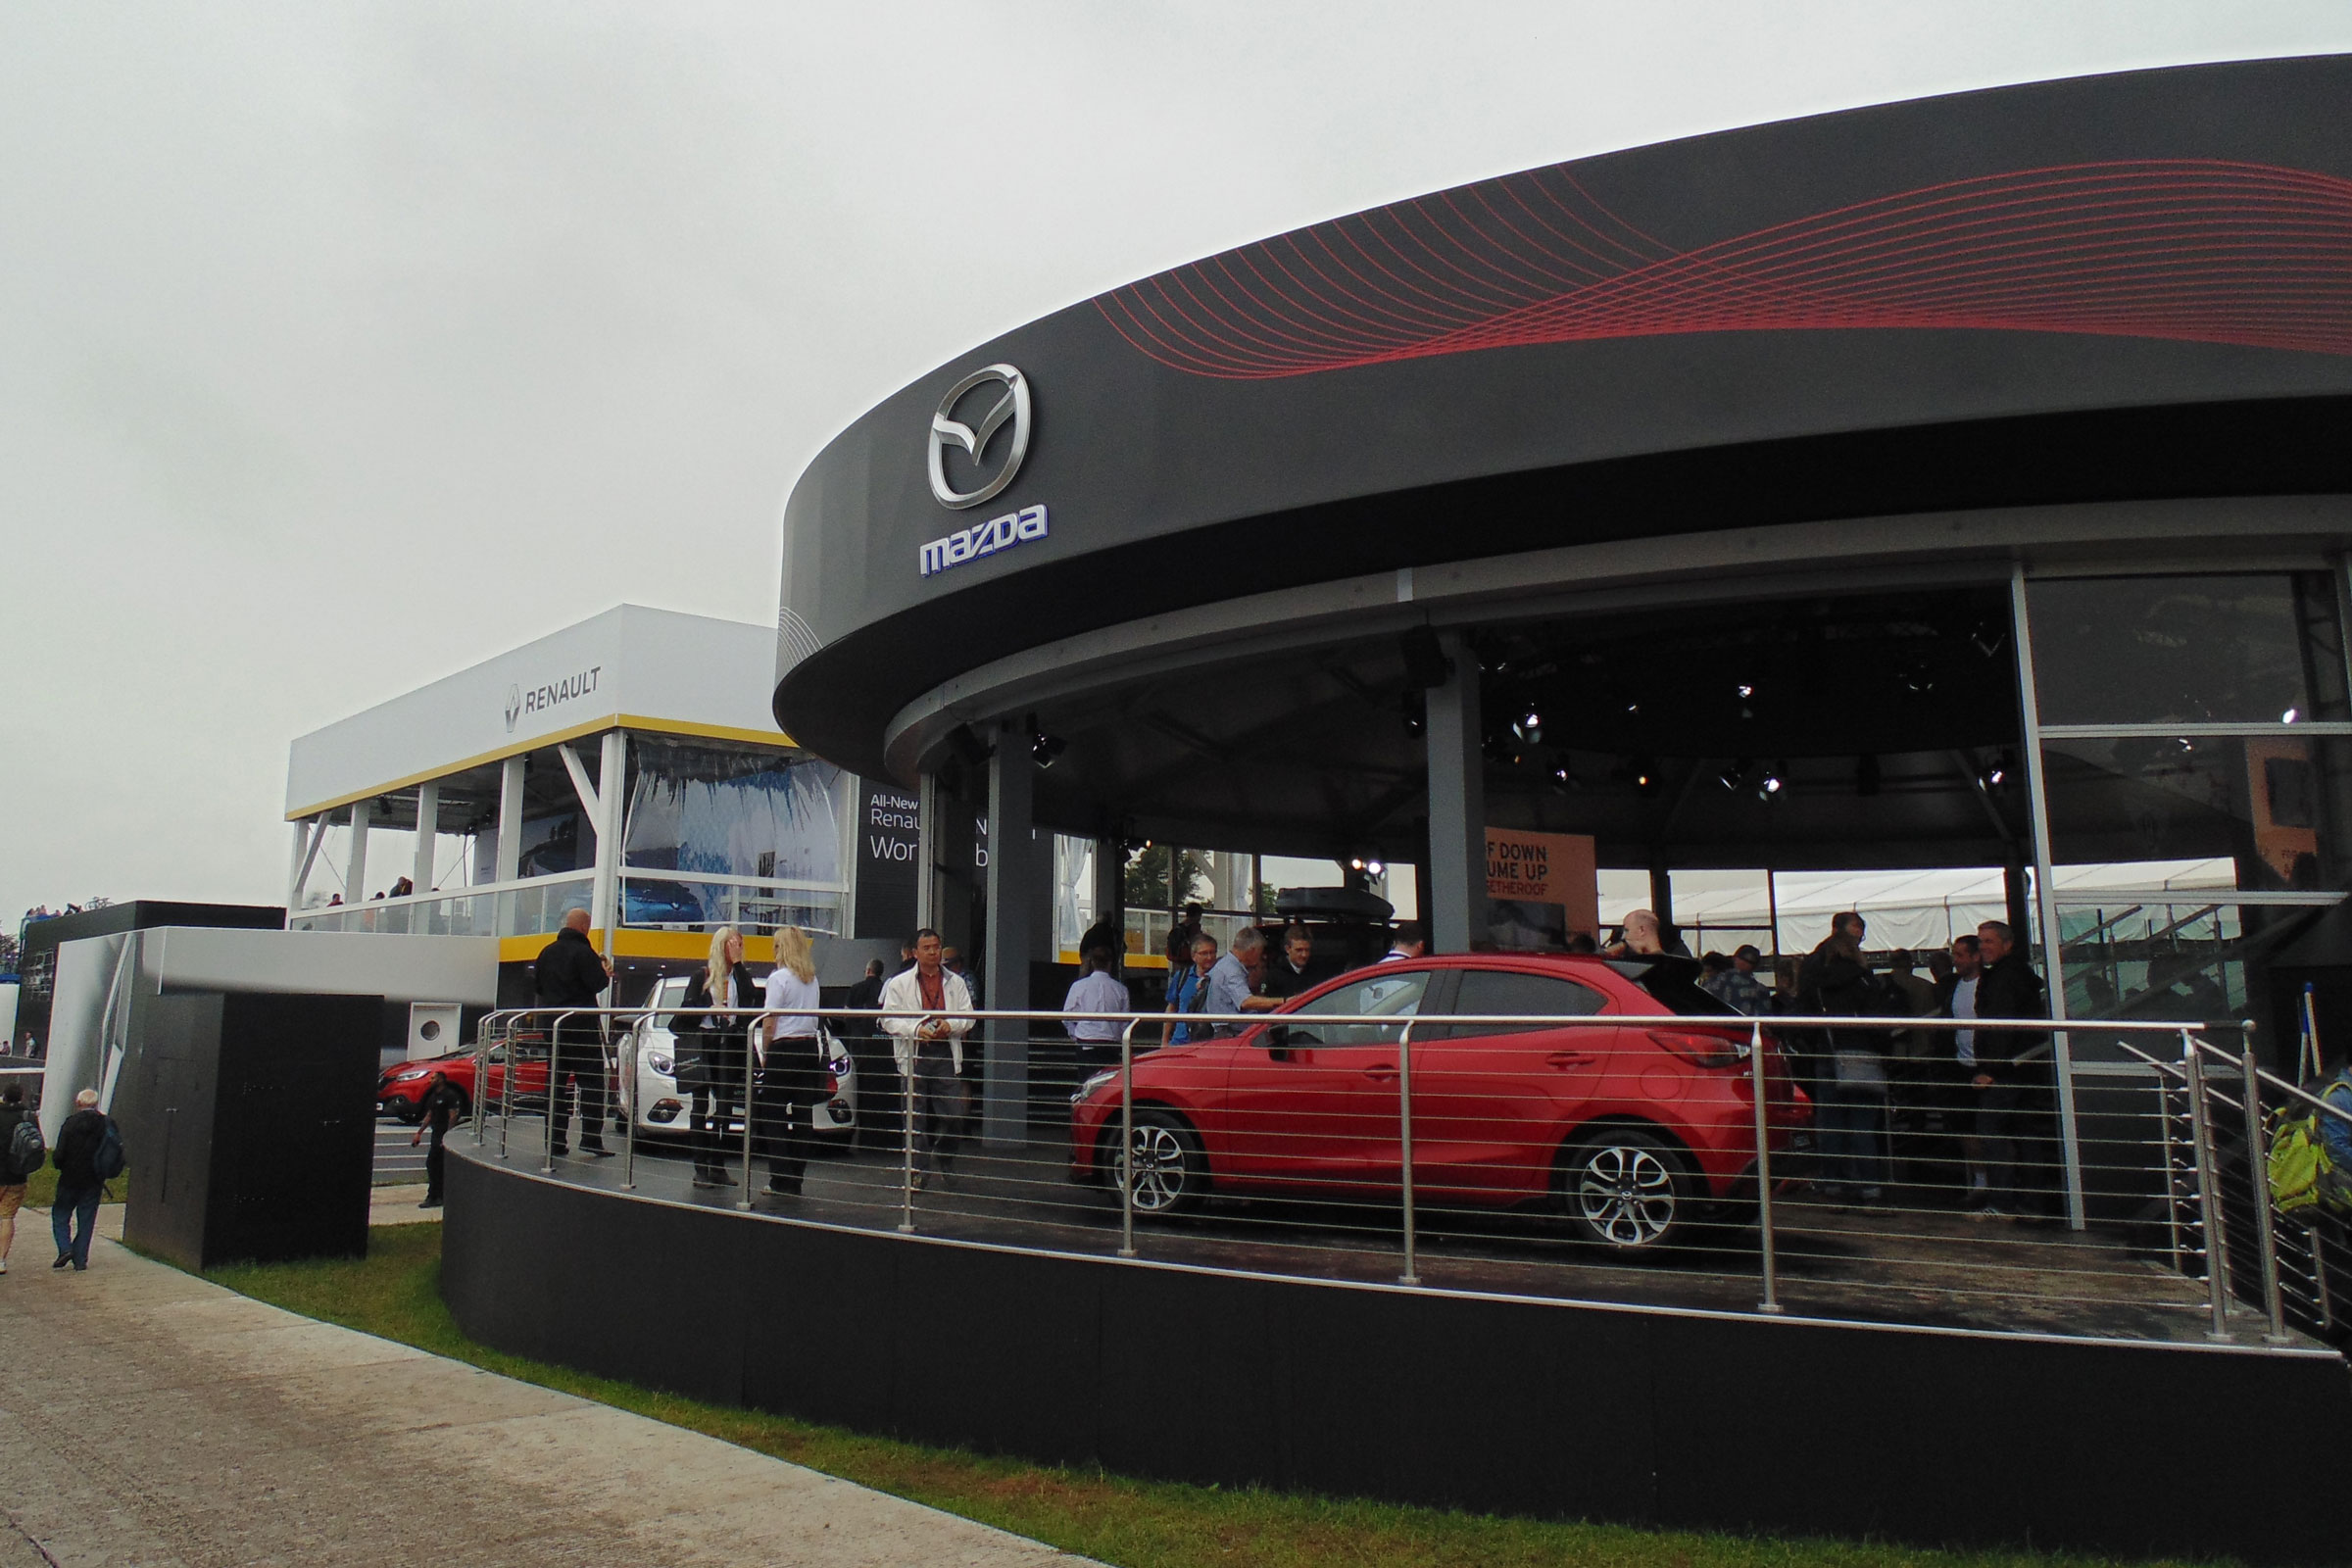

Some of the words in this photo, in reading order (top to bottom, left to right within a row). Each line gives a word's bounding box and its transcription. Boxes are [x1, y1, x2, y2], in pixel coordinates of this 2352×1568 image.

[525, 666, 601, 713] RENAULT
[870, 794, 918, 809] All-New
[870, 835, 920, 860] Wor
[1499, 842, 1546, 861] DOWN
[1525, 863, 1547, 880] UP
